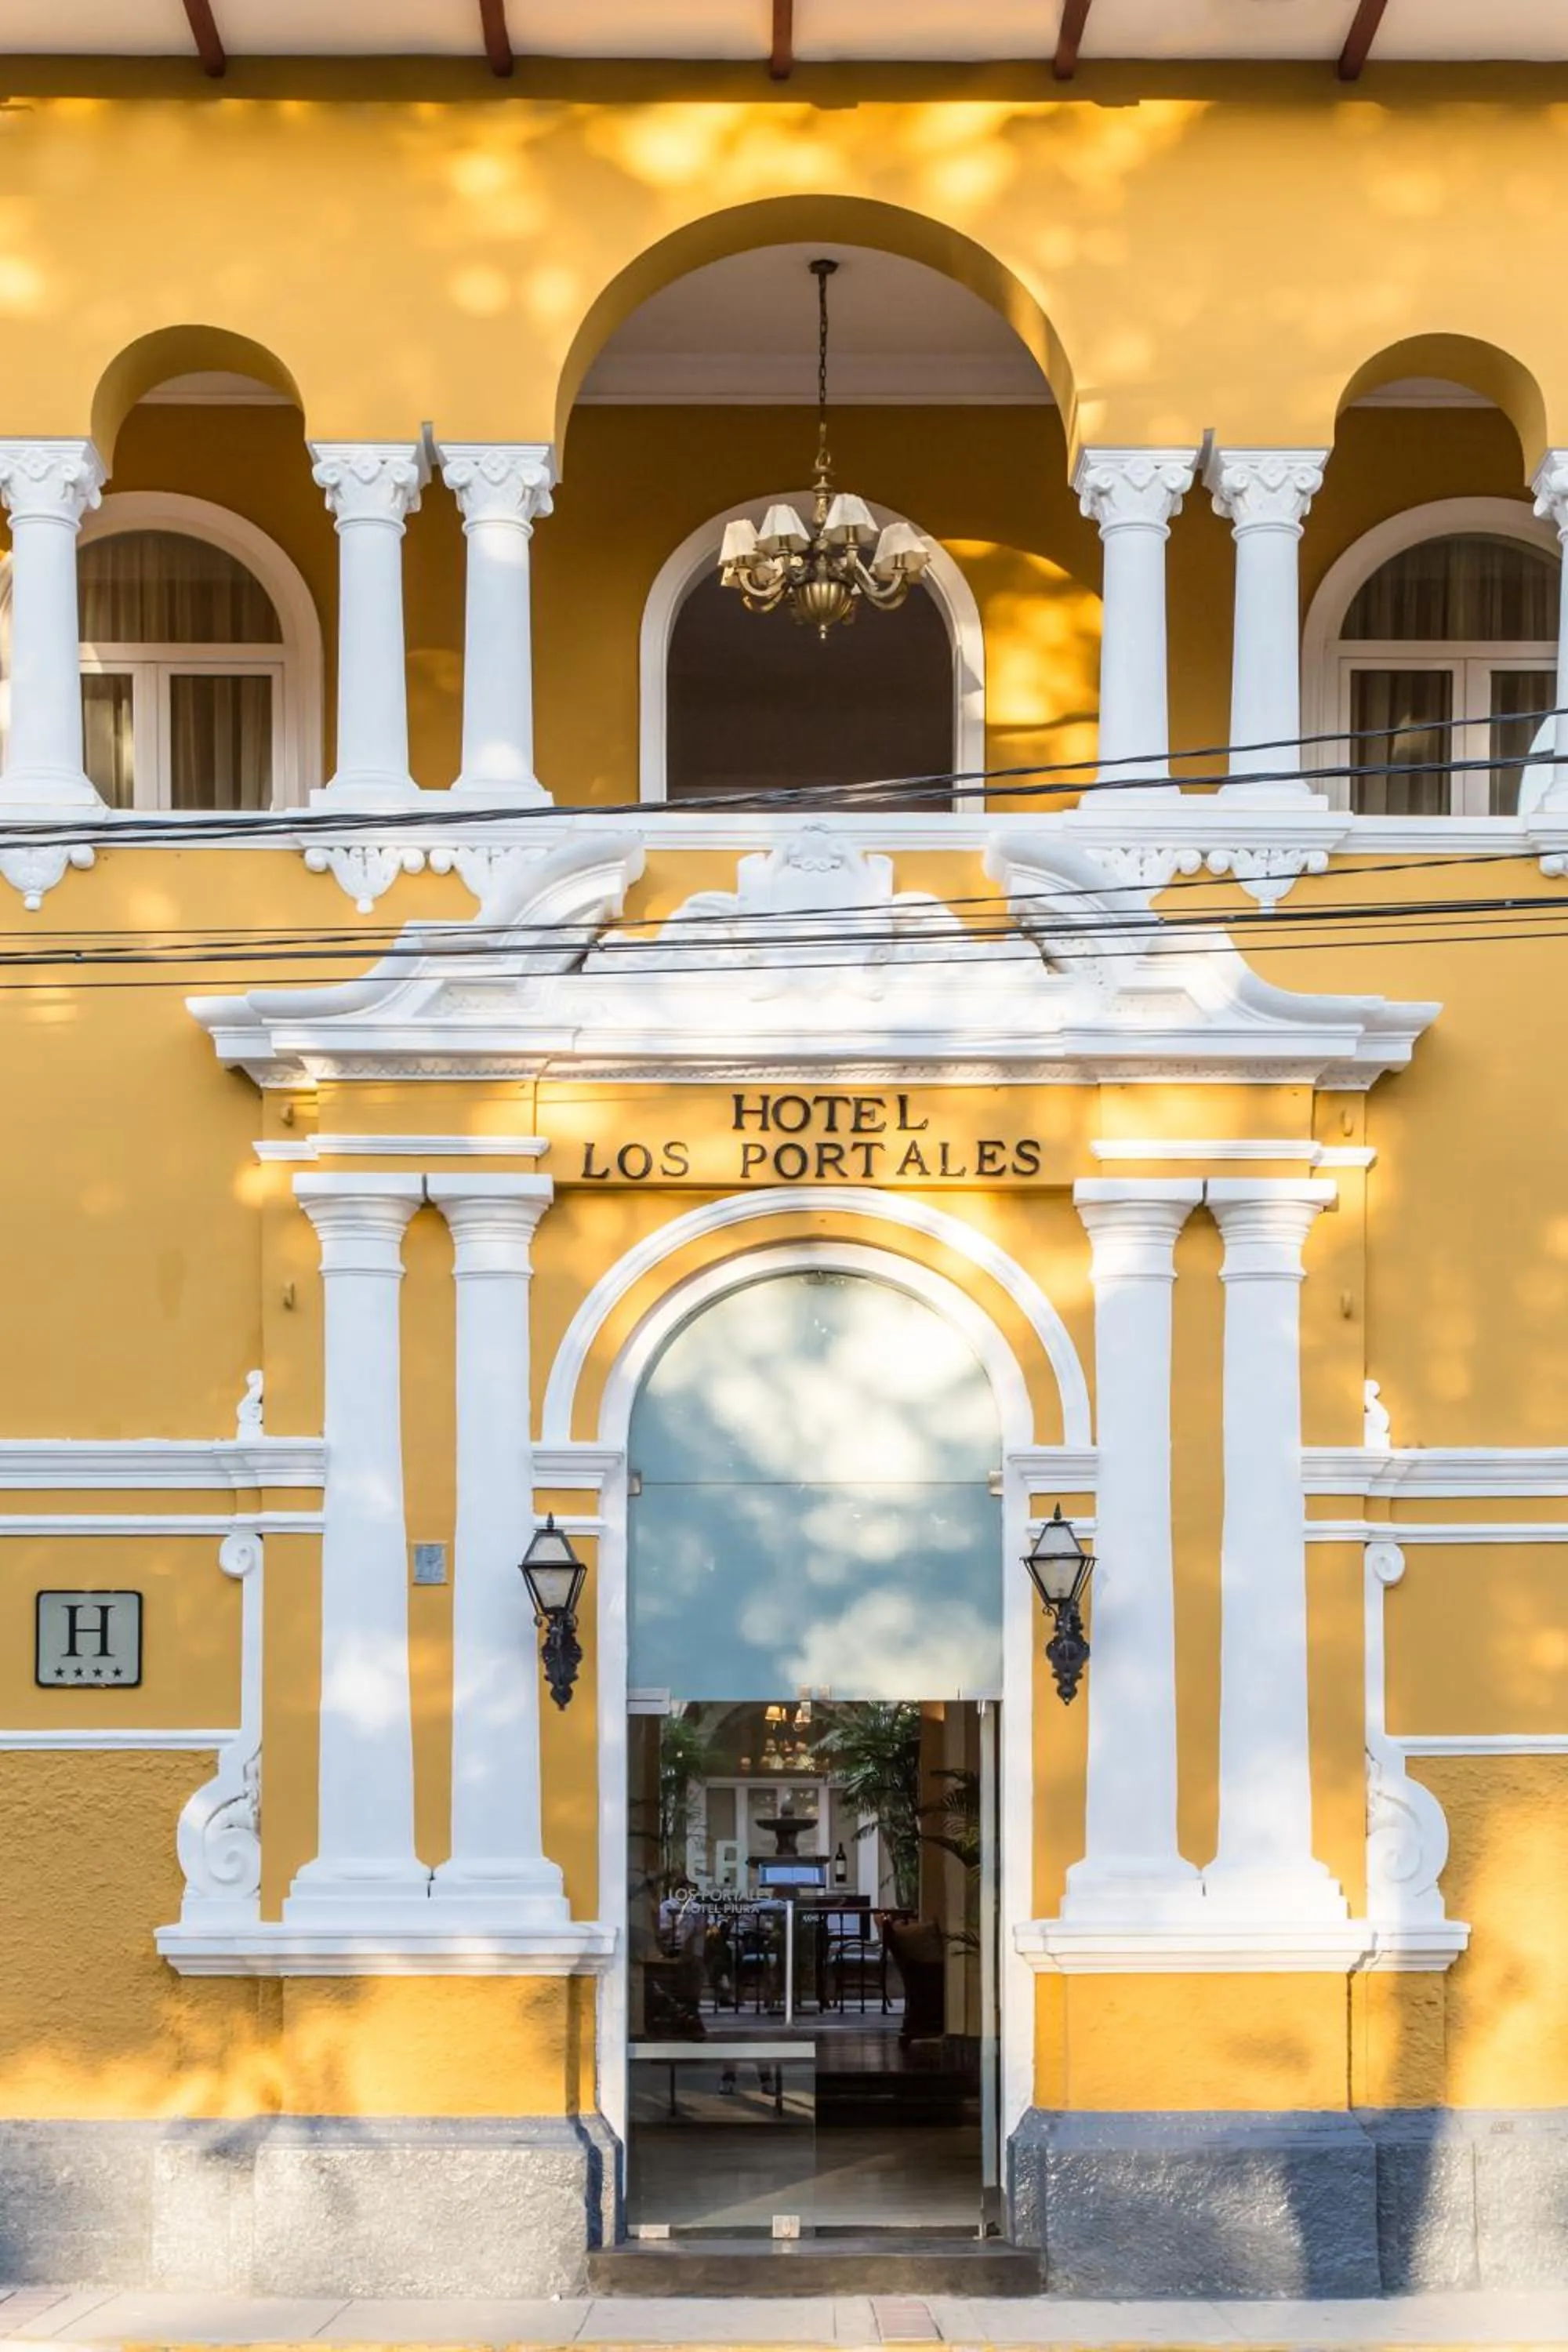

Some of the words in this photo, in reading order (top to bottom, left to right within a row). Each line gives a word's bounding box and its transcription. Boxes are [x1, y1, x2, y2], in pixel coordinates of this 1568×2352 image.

[731, 1094, 929, 1132] HOTEL
[582, 1142, 690, 1179] LOS
[739, 1141, 1041, 1179] PORTALES
[61, 1605, 116, 1657] H
[669, 1888, 698, 1901] LOS
[700, 1888, 772, 1901] PORTALES
[724, 1903, 760, 1914] PIURA
